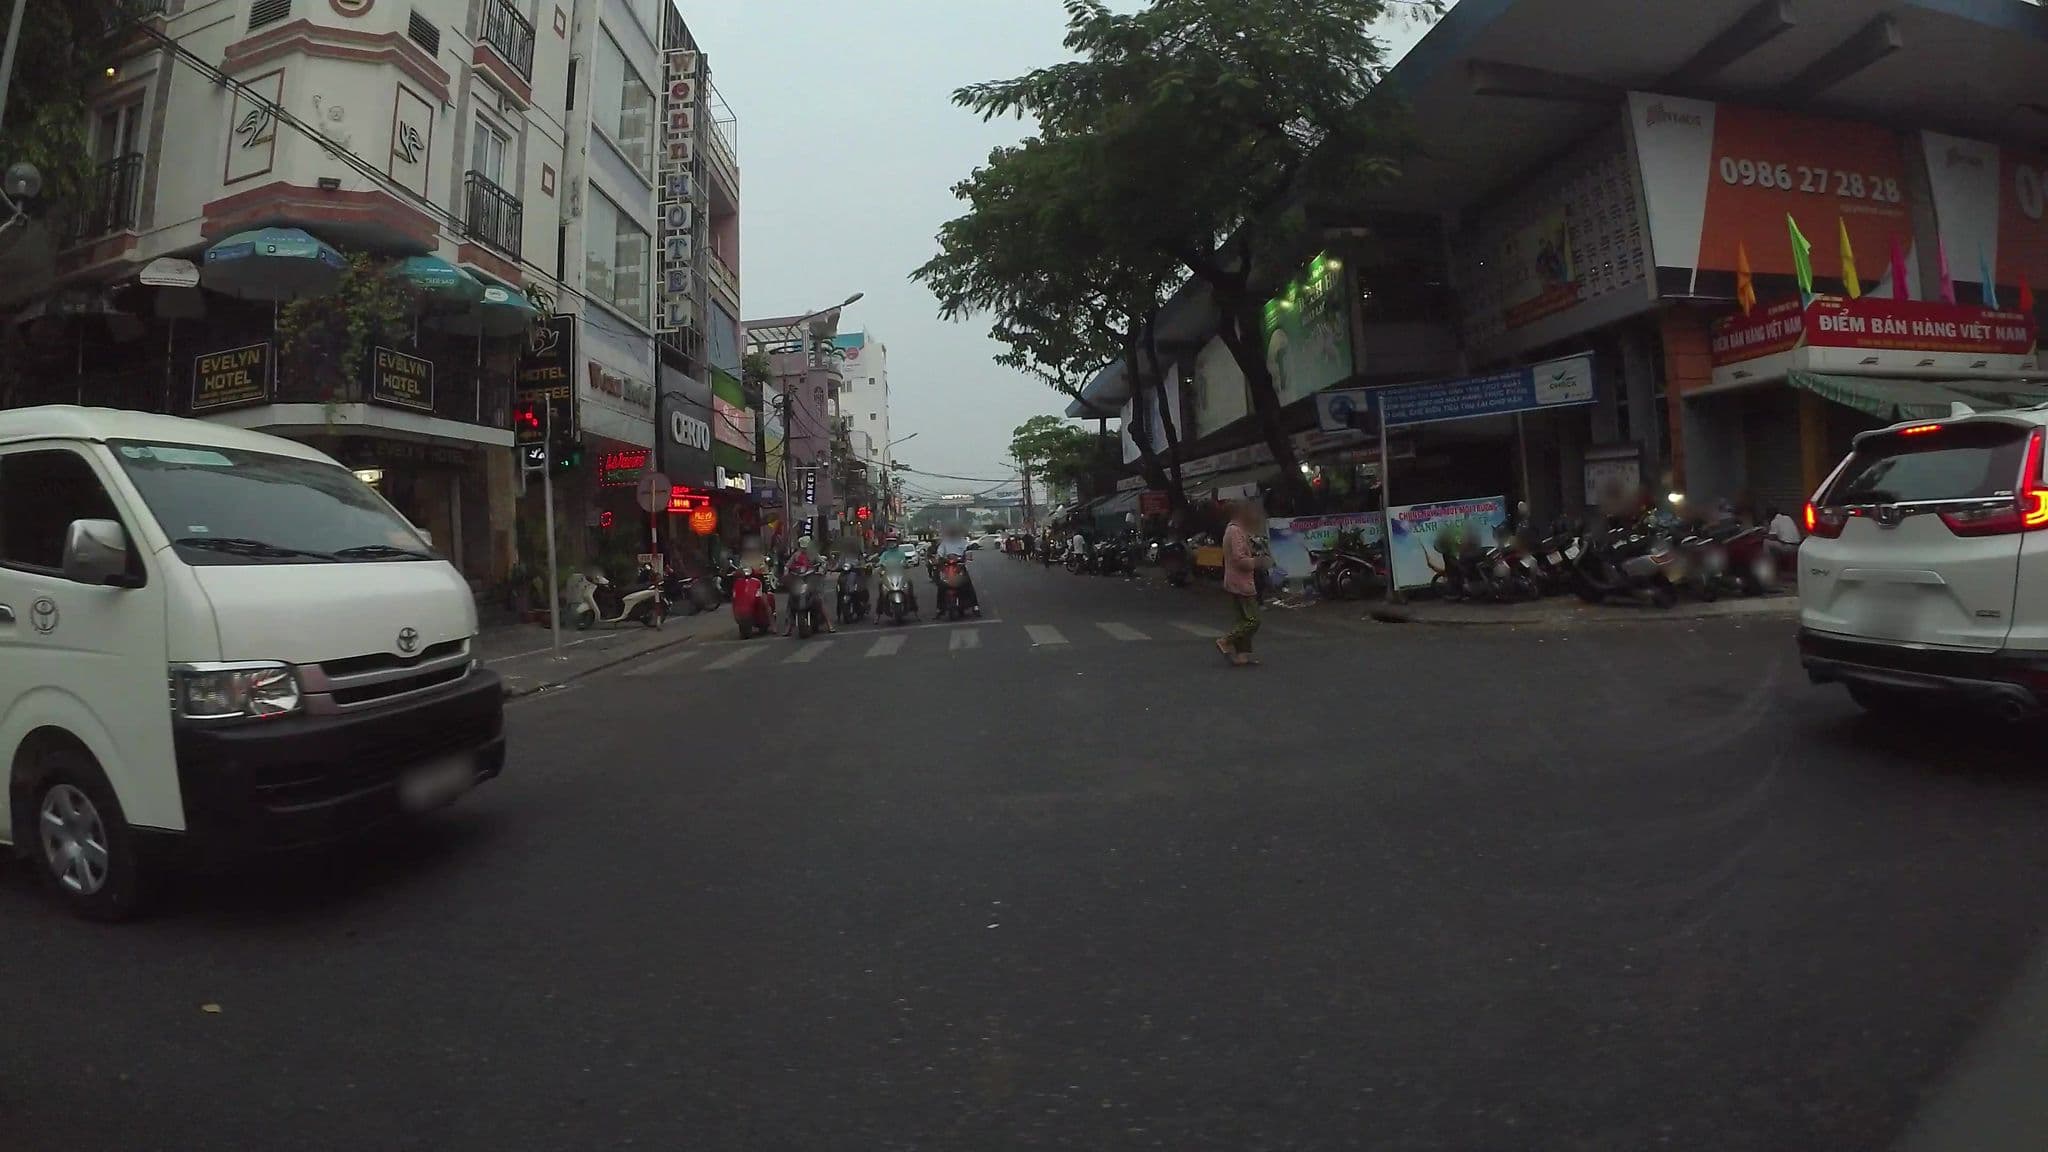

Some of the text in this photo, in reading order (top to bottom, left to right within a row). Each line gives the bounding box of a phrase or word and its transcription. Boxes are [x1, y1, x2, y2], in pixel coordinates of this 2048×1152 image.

[1719, 156, 1900, 203] 0986 27 28 28
[666, 175, 690, 326] HOTEL
[1819, 308, 1865, 334] ĐIỂM
[1872, 313, 1908, 335] BÁN
[1912, 317, 1957, 338] HÀNG
[1960, 320, 1991, 342] VIỆT
[1995, 326, 2027, 341] NAM
[201, 349, 261, 374] EVELYN
[379, 353, 426, 377] EVELYN
[204, 370, 252, 391] HOTEL
[383, 373, 420, 395] HOTEL
[671, 411, 710, 451] CERTO
